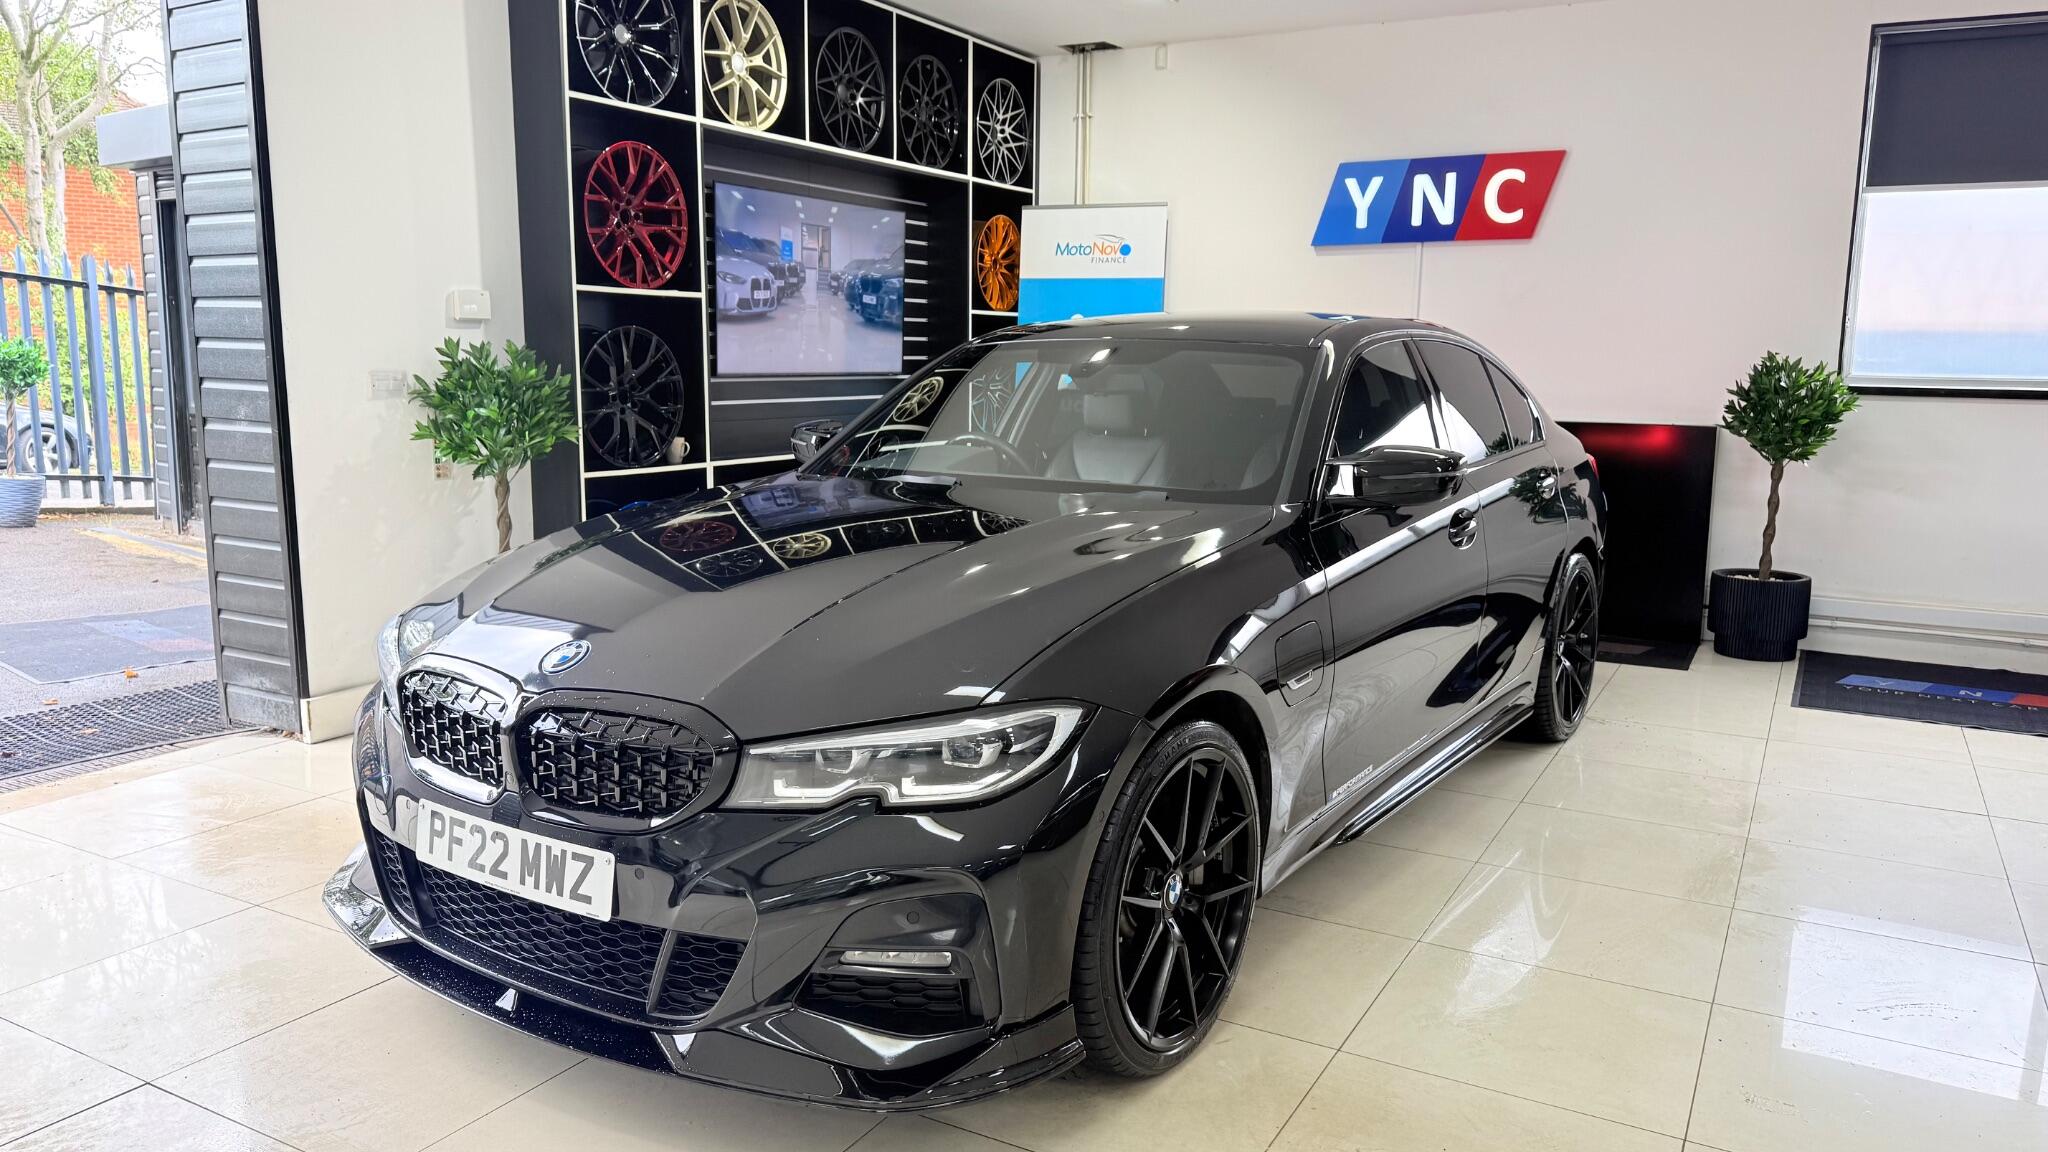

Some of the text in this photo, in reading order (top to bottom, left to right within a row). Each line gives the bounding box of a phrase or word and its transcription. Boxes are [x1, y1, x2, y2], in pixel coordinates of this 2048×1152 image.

[1344, 168, 1526, 230] YNC
[1090, 256, 1127, 264] FINANCE
[428, 809, 595, 906] PF22 MWZ
